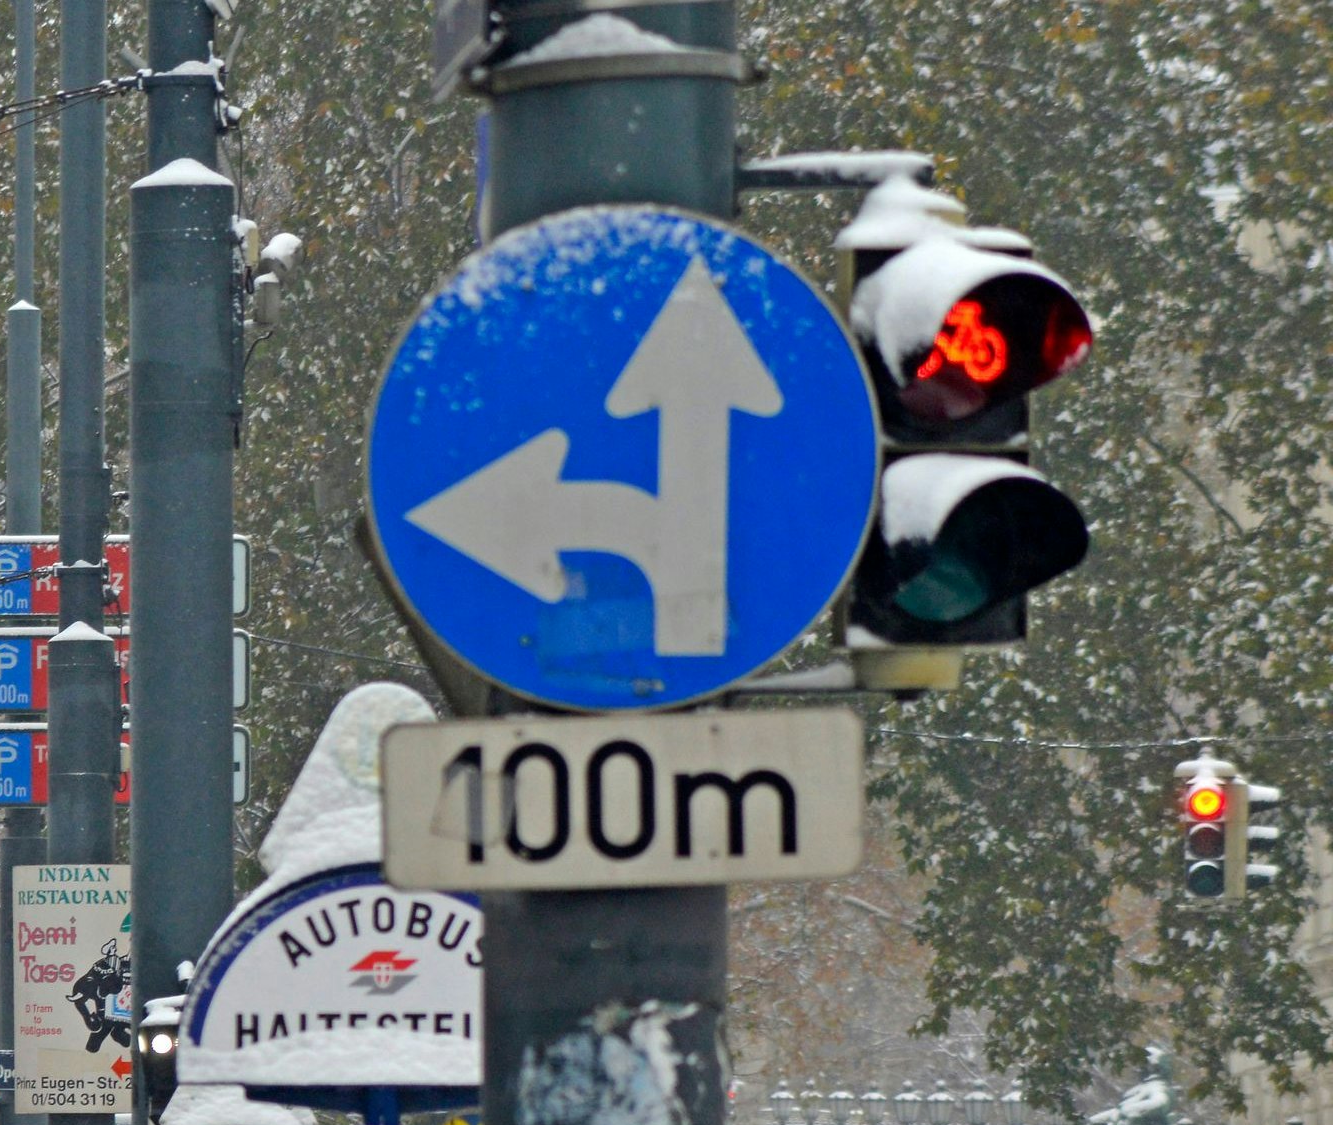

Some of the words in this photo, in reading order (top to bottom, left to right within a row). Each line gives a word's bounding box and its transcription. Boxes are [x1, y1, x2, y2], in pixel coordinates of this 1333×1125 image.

[38, 867, 110, 882] INDIAN
[19, 955, 76, 984] Tass
[32, 1004, 53, 1013] Tram
[33, 1016, 42, 1024] to
[16, 1077, 36, 1089] Prinz
[32, 1093, 77, 1106] 01/504
